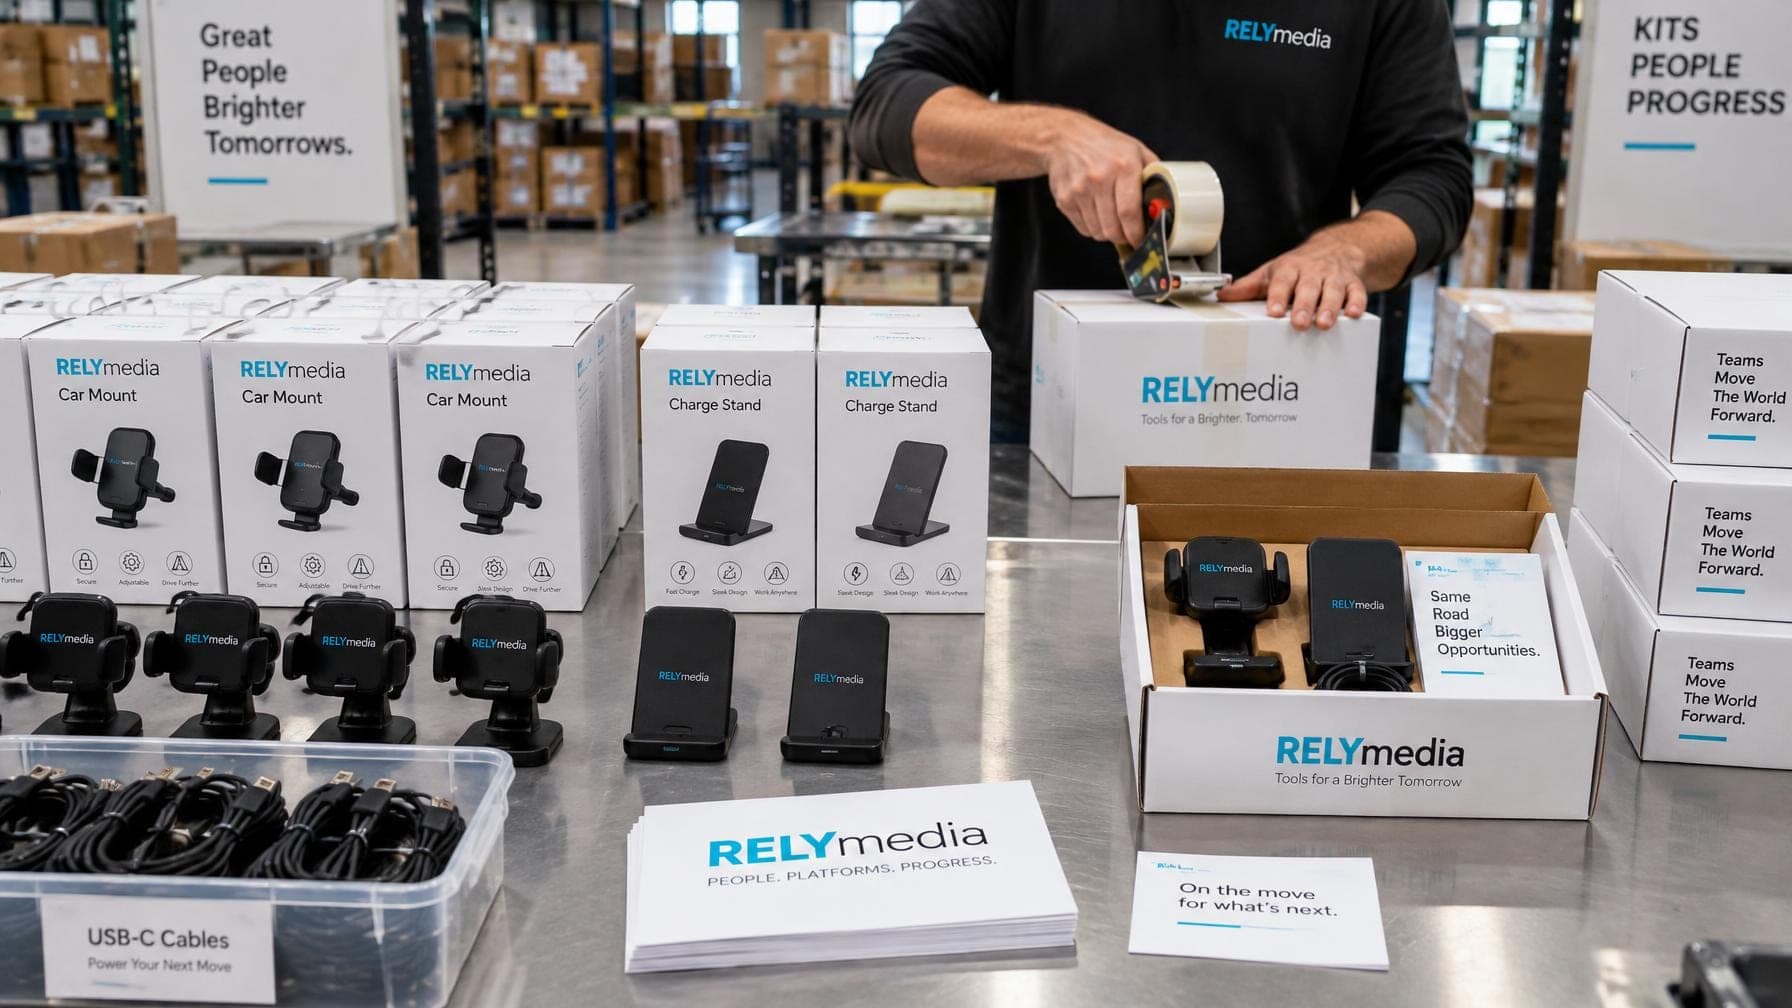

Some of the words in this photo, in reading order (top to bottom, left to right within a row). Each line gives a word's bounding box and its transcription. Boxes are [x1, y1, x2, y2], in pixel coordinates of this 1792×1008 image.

[200, 23, 272, 48] Great
[1224, 18, 1332, 49] RELYmedia
[1634, 16, 1700, 42] KITS
[202, 58, 287, 89] People
[1631, 53, 1742, 78] PEOPLE
[204, 94, 306, 125] Brighter
[1627, 90, 1786, 115] PROGRESS
[204, 130, 353, 155] Tomorrows.
[56, 357, 160, 376] RELYmedia
[1717, 353, 1764, 367] Teams
[240, 360, 345, 379] RELYmedia
[425, 363, 531, 382] RELYmedia
[668, 369, 772, 387] RELYmedia
[845, 370, 948, 388] RELYmedia
[1714, 371, 1756, 385] Move
[58, 387, 84, 402] Car
[88, 388, 137, 402] Mount
[1141, 374, 1299, 403] RELYmedia
[242, 390, 269, 404] Car
[273, 390, 323, 404] Mount
[426, 392, 453, 407] Car
[458, 393, 508, 407] Mount
[1713, 389, 1739, 403] The
[1744, 390, 1787, 405] World
[669, 398, 719, 413] Charge
[722, 398, 761, 411] Stand
[845, 400, 894, 415] Charge
[898, 400, 937, 413] Stand
[1141, 413, 1168, 425] Tools
[1171, 413, 1186, 424] for
[1188, 416, 1195, 424] a
[1245, 412, 1297, 423] Tomorrow
[1711, 408, 1776, 423] Forward.
[1705, 506, 1752, 521] Teams
[1703, 525, 1743, 538] Move
[1701, 543, 1727, 556] The
[1732, 544, 1775, 559] World
[1200, 563, 1253, 574] RELYmedia
[1698, 561, 1763, 576] Forward.
[1332, 598, 1385, 611] RELYmedia
[1431, 590, 1472, 603] Same
[1433, 607, 1470, 620] Road
[40, 633, 94, 645] RELYmedia
[185, 633, 239, 646] RELYmedia
[1435, 624, 1483, 640] Bigger
[322, 635, 376, 648] RELYmedia
[472, 638, 527, 650] RELYmedia
[1437, 643, 1541, 658] Opportunities.
[1688, 656, 1735, 671] Teams
[658, 671, 710, 683] RELYmedia
[813, 673, 865, 685] RELYmedia
[1685, 673, 1726, 688] Move
[1683, 692, 1710, 705] The
[1714, 693, 1757, 708] World
[1681, 709, 1745, 725] Forward.
[1276, 736, 1465, 767] RELYmedia
[1275, 772, 1308, 785] Tools
[1312, 773, 1329, 785] for
[1332, 776, 1340, 785] a
[1344, 774, 1394, 788] Brighter
[1398, 775, 1463, 787] Tomorrow
[708, 821, 989, 868] RELYmedia
[707, 873, 781, 887] PEOPLE.
[786, 863, 896, 882] PLATFORMS.
[900, 855, 997, 873] PROGRESS.
[1180, 883, 1210, 895] On
[1216, 885, 1251, 897] the
[1258, 889, 1316, 900] move
[1179, 898, 1208, 909] for
[1214, 899, 1280, 914] what's
[1287, 904, 1338, 917] next.
[87, 928, 155, 947] USB-C
[161, 930, 230, 949] Cables
[88, 957, 128, 970] Power
[131, 958, 159, 971] Your
[163, 959, 193, 972] Next
[197, 960, 232, 973] Move
